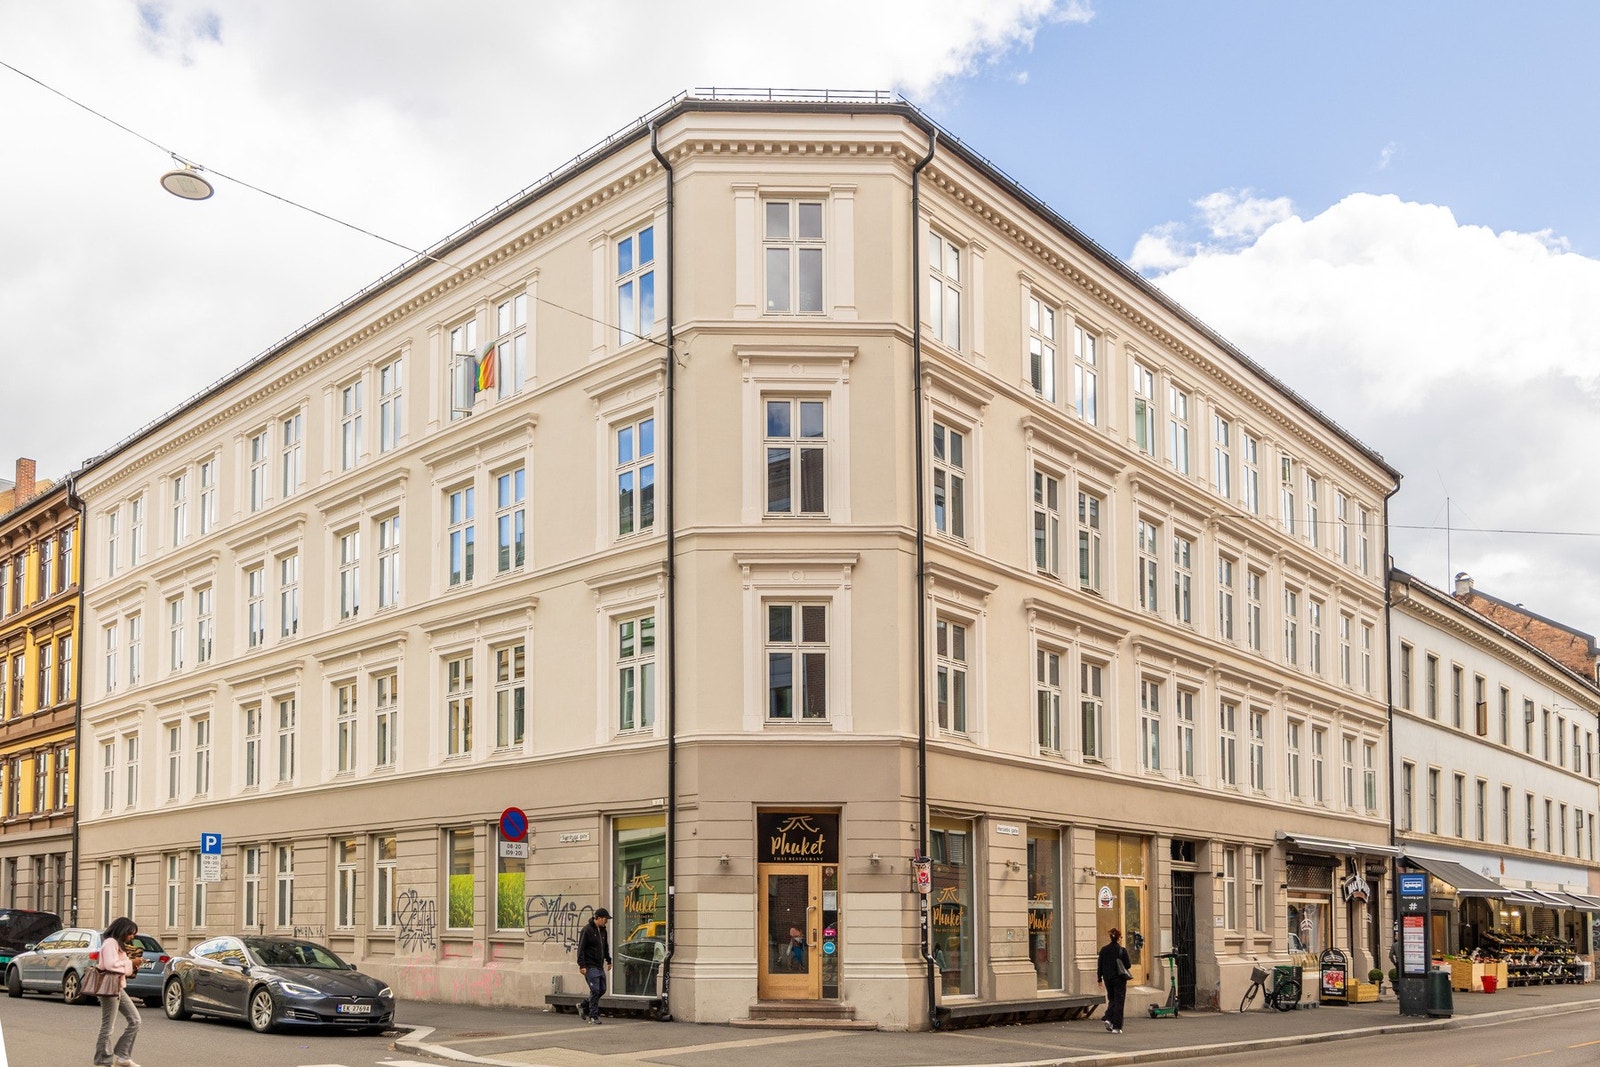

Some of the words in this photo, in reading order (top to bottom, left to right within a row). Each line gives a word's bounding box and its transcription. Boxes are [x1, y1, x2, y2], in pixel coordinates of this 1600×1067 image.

[206, 835, 217, 852] P
[770, 832, 826, 856] Phuket
[623, 891, 659, 913] Phuket
[933, 904, 964, 926] Phuket
[1028, 909, 1054, 930] Phuket
